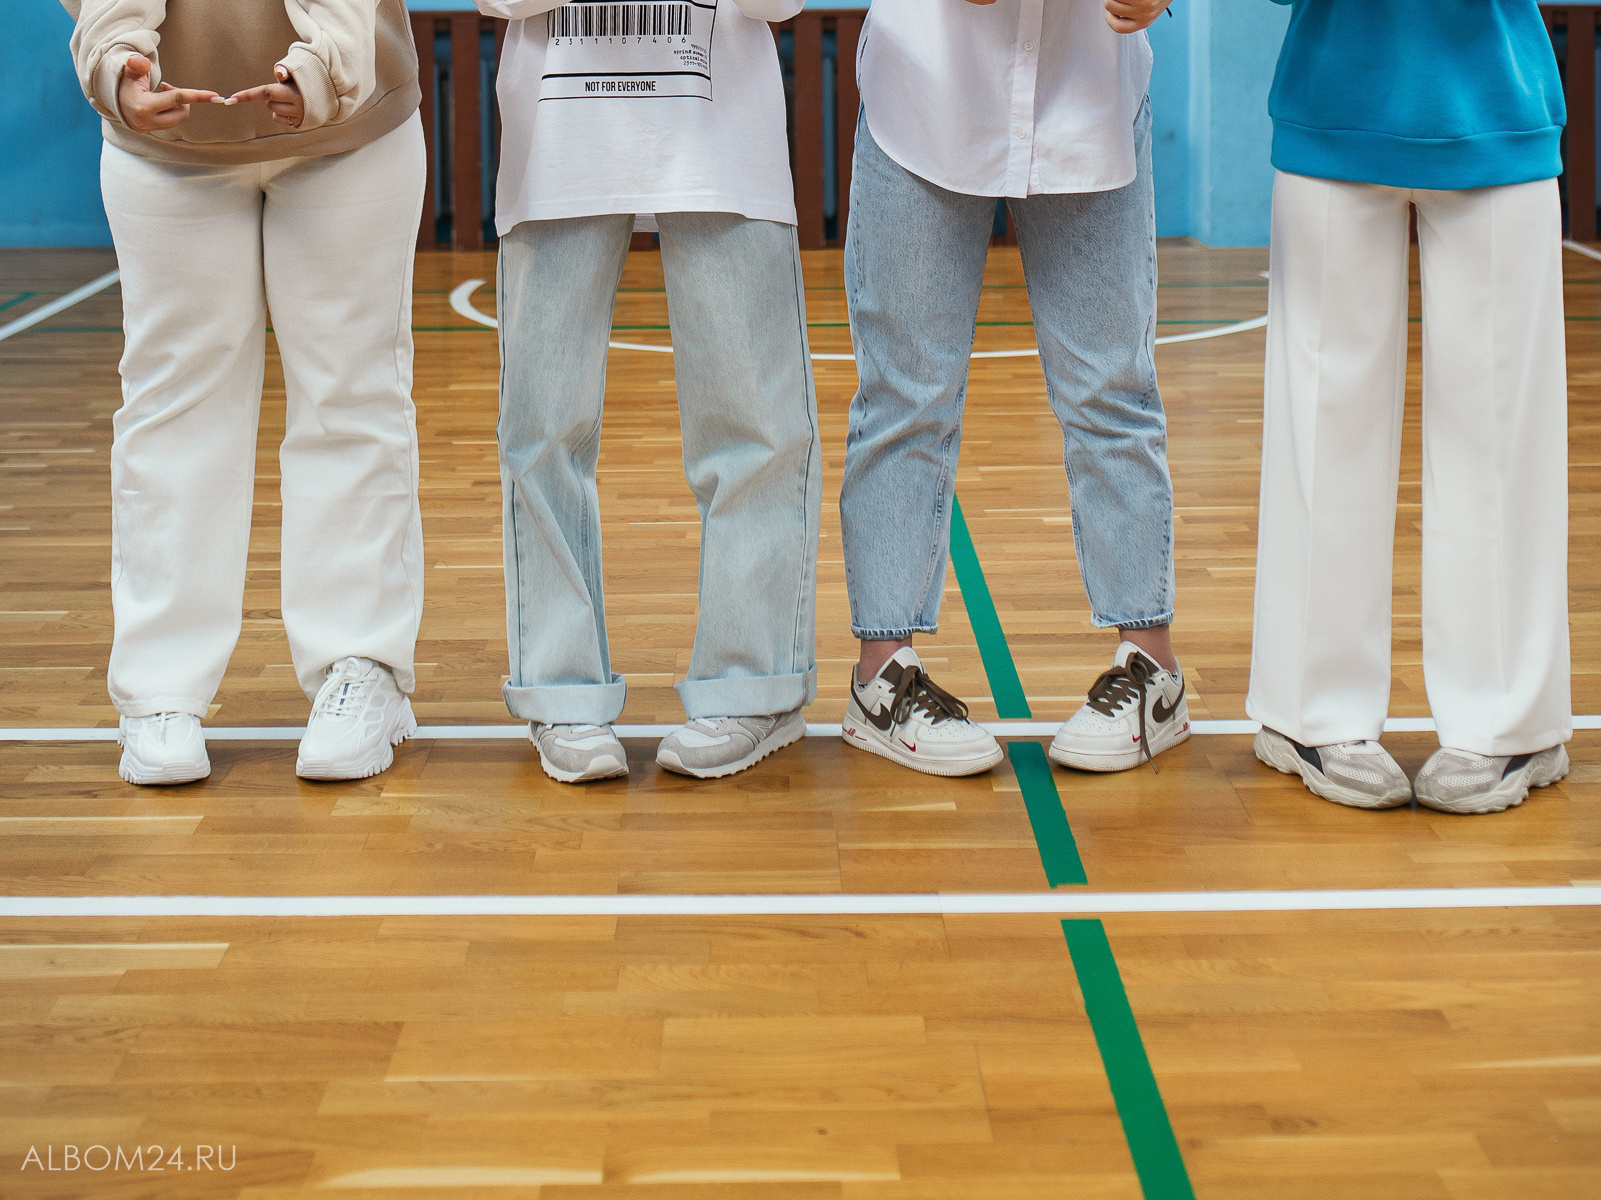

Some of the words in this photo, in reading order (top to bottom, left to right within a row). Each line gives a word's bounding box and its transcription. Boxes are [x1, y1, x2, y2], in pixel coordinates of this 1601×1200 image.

[584, 81, 600, 92] NOT
[601, 81, 616, 92] FOR
[617, 80, 657, 92] EVERYONE
